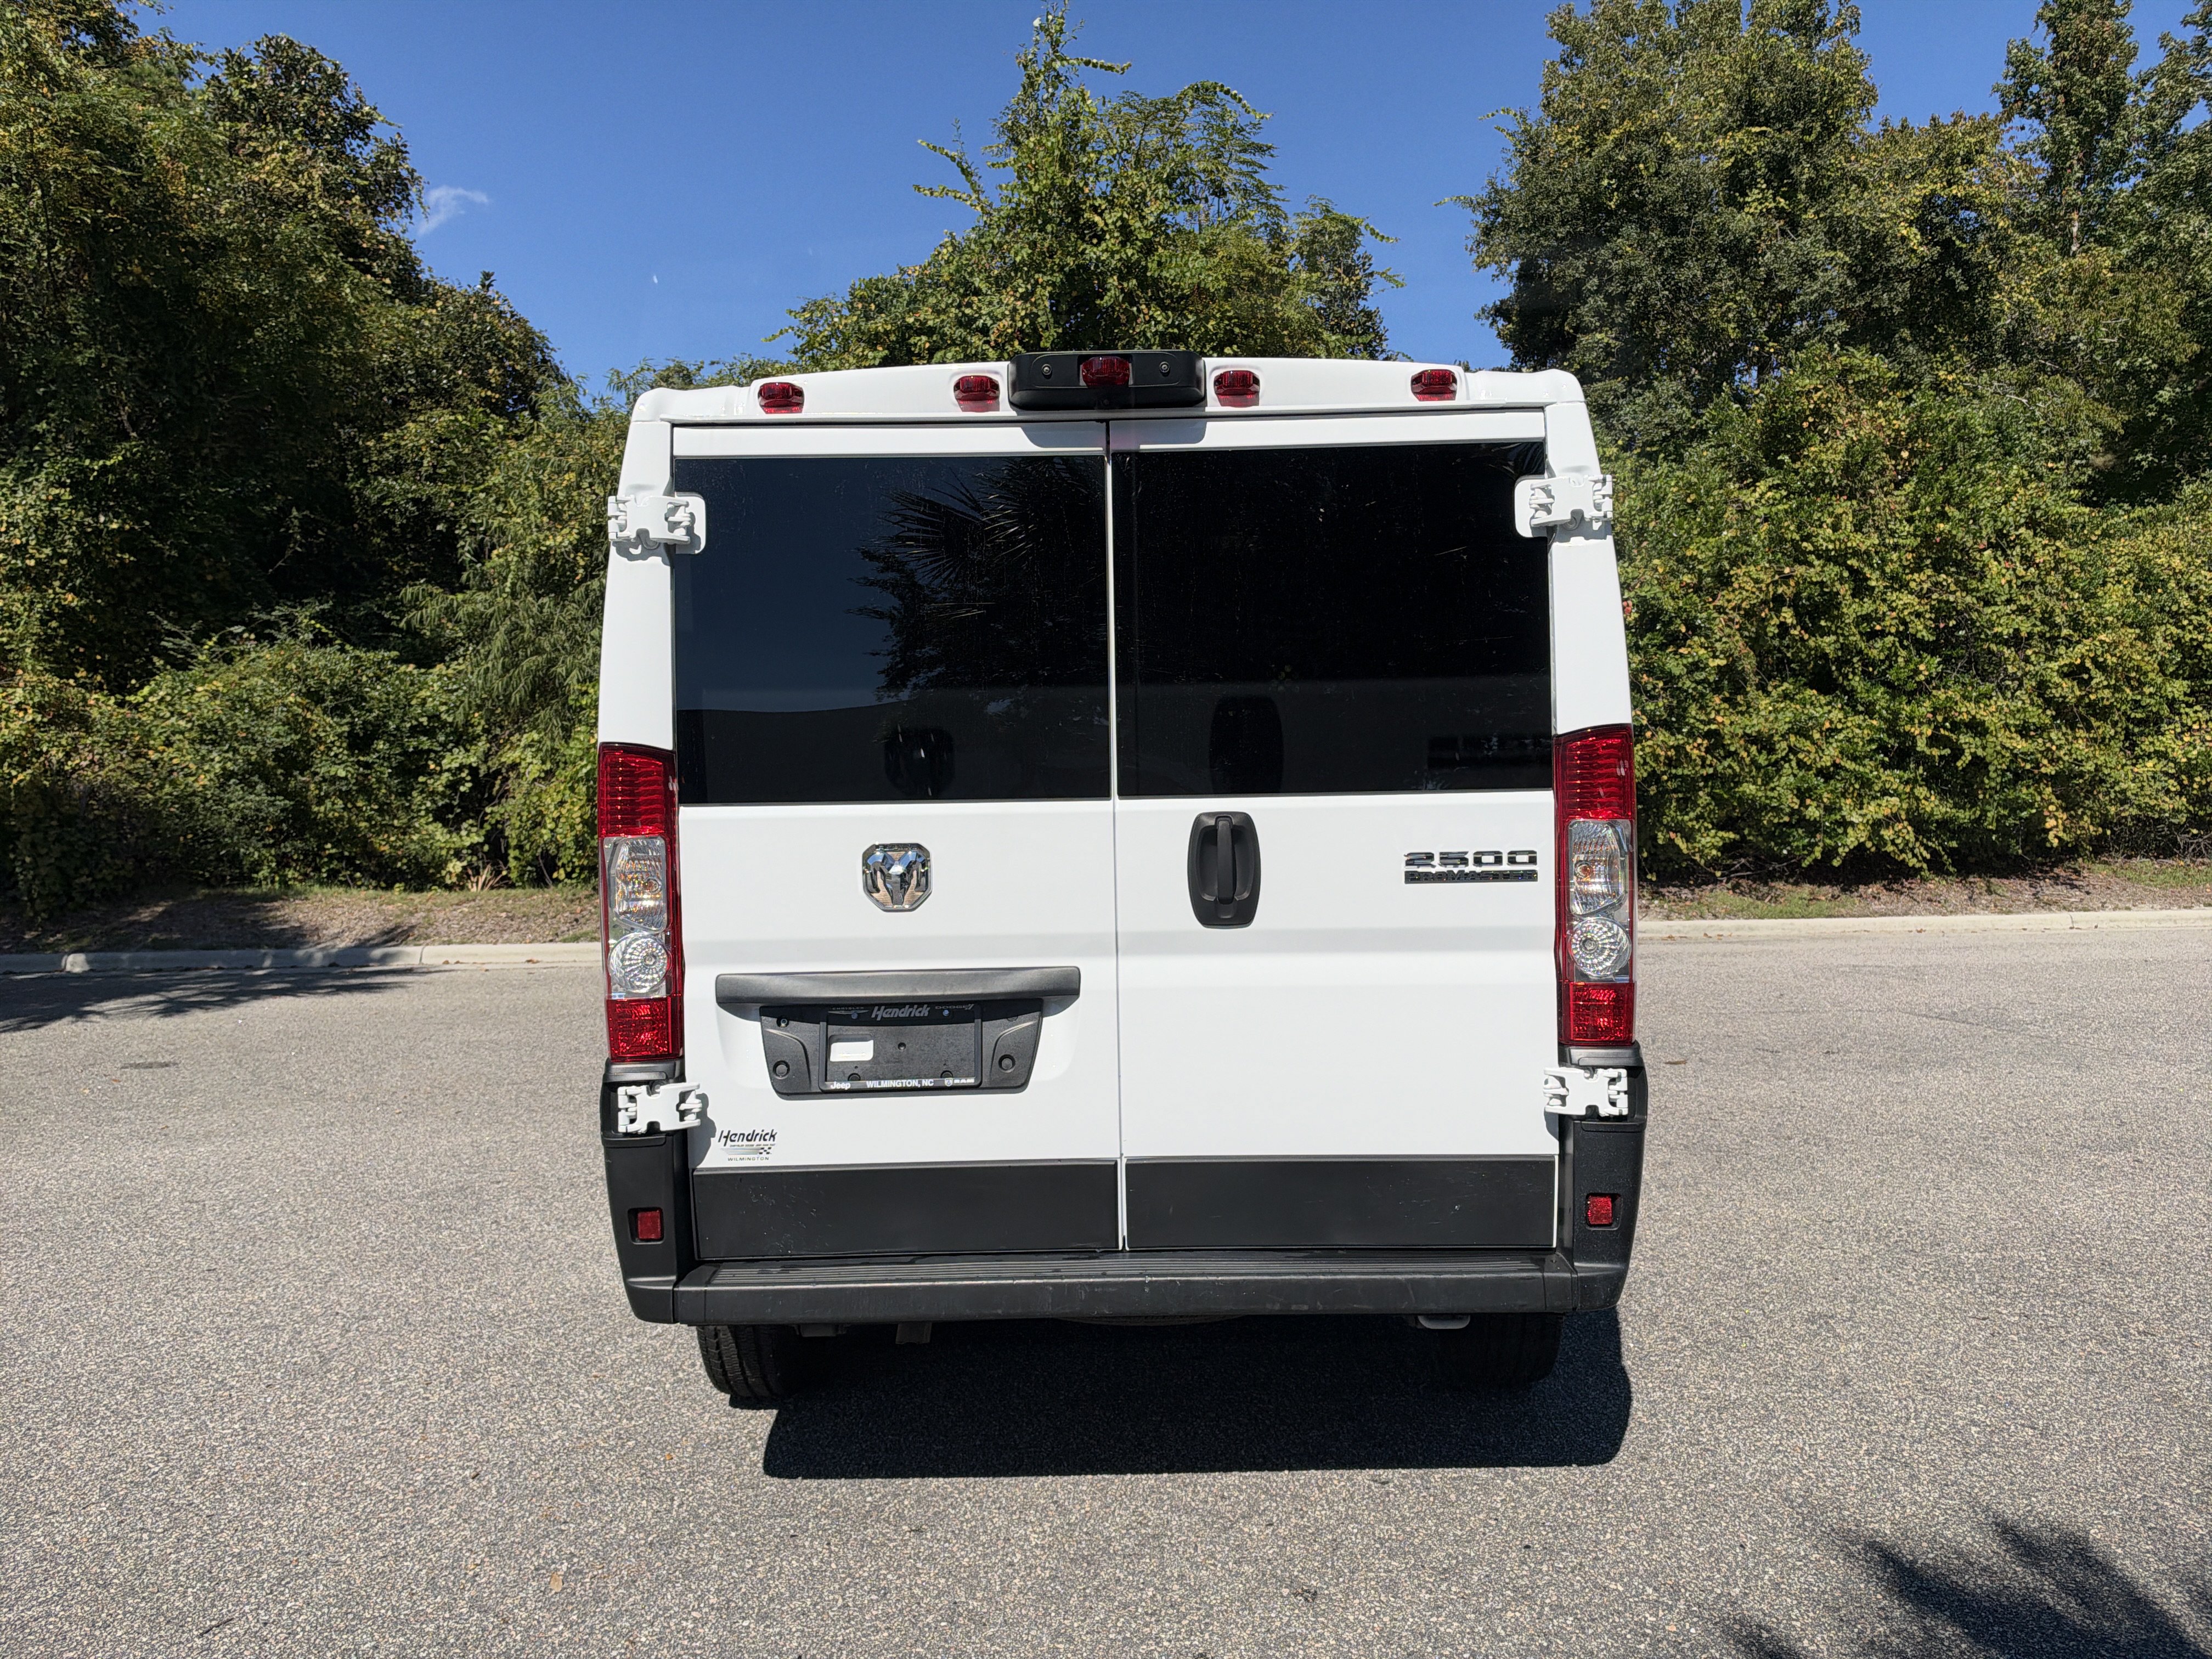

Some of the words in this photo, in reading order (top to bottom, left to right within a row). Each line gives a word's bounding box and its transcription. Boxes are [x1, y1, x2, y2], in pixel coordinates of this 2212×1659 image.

[1403, 850, 1537, 868] 2500
[1404, 870, 1538, 883] PROMASTER
[871, 1004, 931, 1021] Hendrick
[830, 1081, 850, 1090] Jeep
[866, 1079, 921, 1088] WILMINGTON,
[718, 1129, 777, 1147] Hendrick
